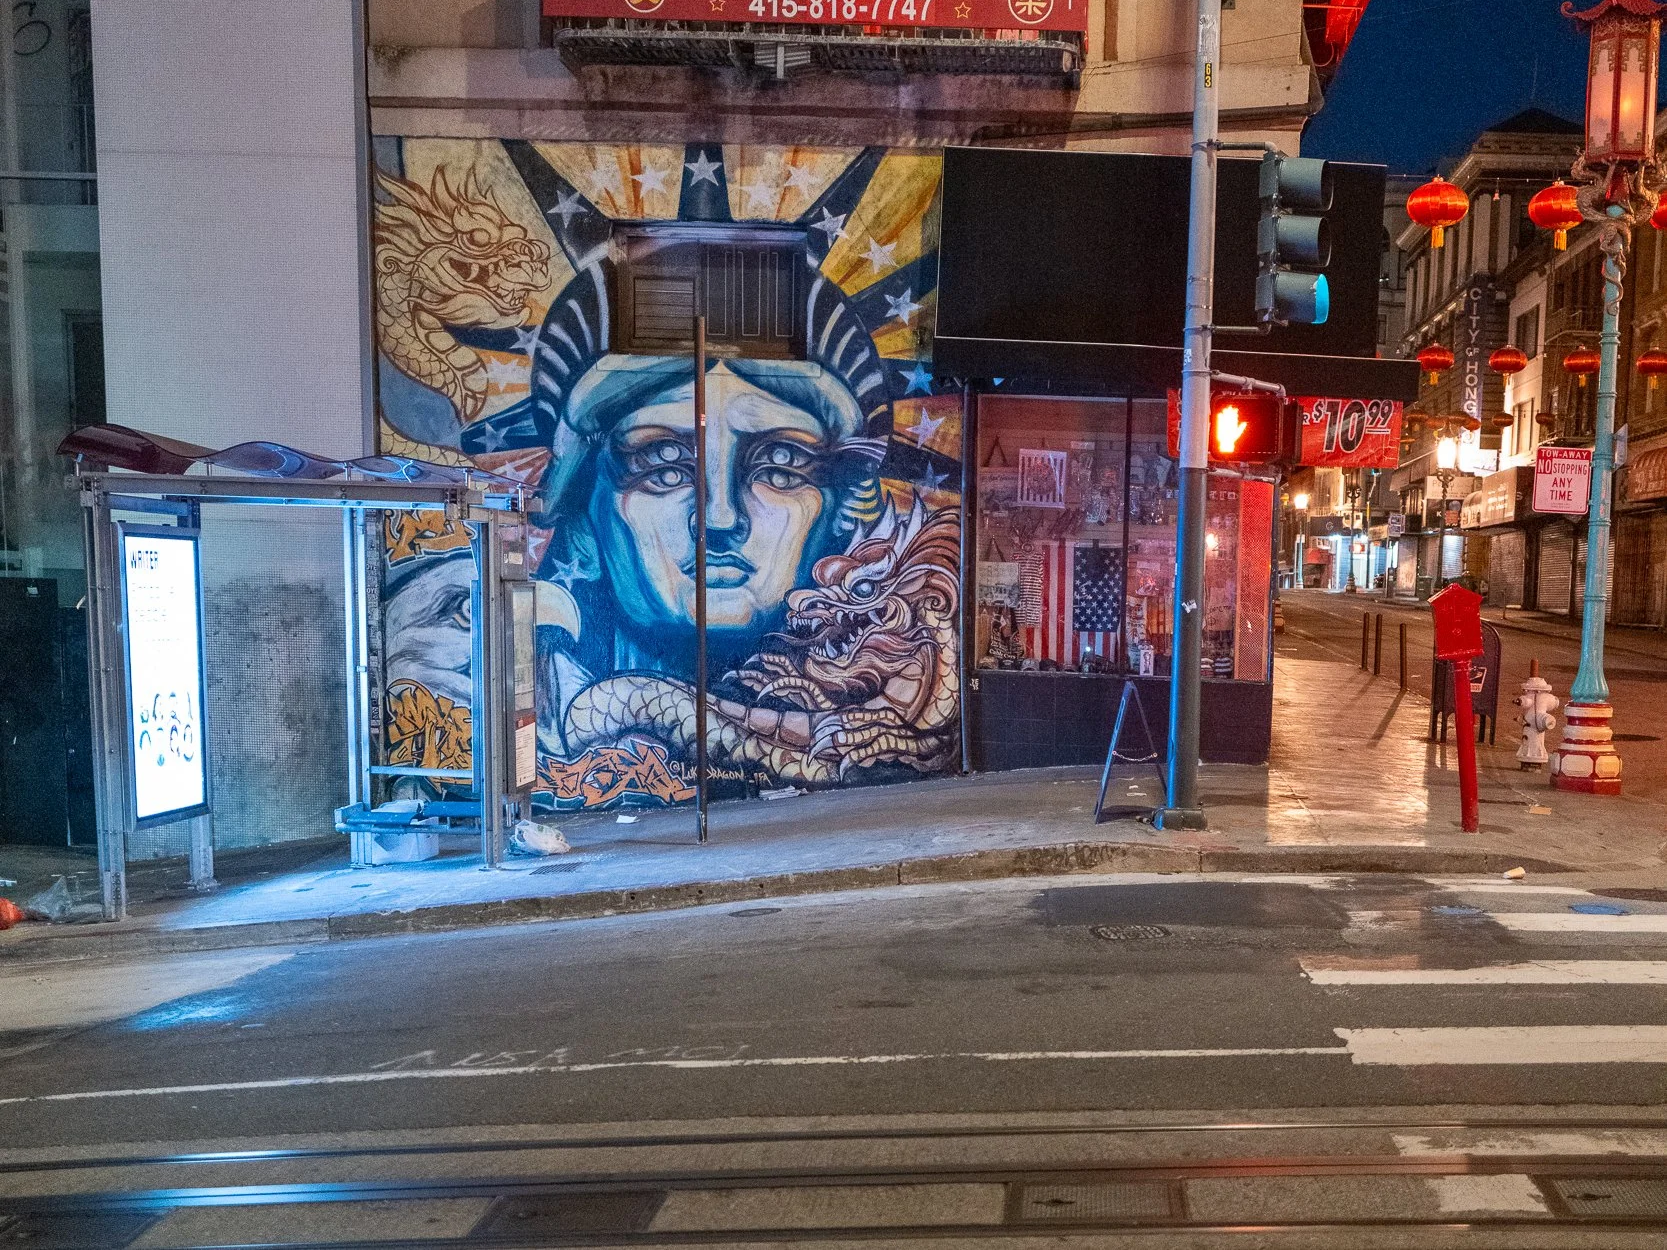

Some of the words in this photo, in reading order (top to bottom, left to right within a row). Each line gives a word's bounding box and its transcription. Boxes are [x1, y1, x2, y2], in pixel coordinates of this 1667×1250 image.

[1205, 63, 1212, 88] 63
[1468, 287, 1482, 344] CITY
[1463, 361, 1478, 414] HONG
[1540, 449, 1588, 460] TOW-AWAY
[1537, 458, 1552, 474] NO
[1552, 462, 1588, 476] STOPPING
[1551, 477, 1573, 489] ANY
[1549, 489, 1573, 502] TIME
